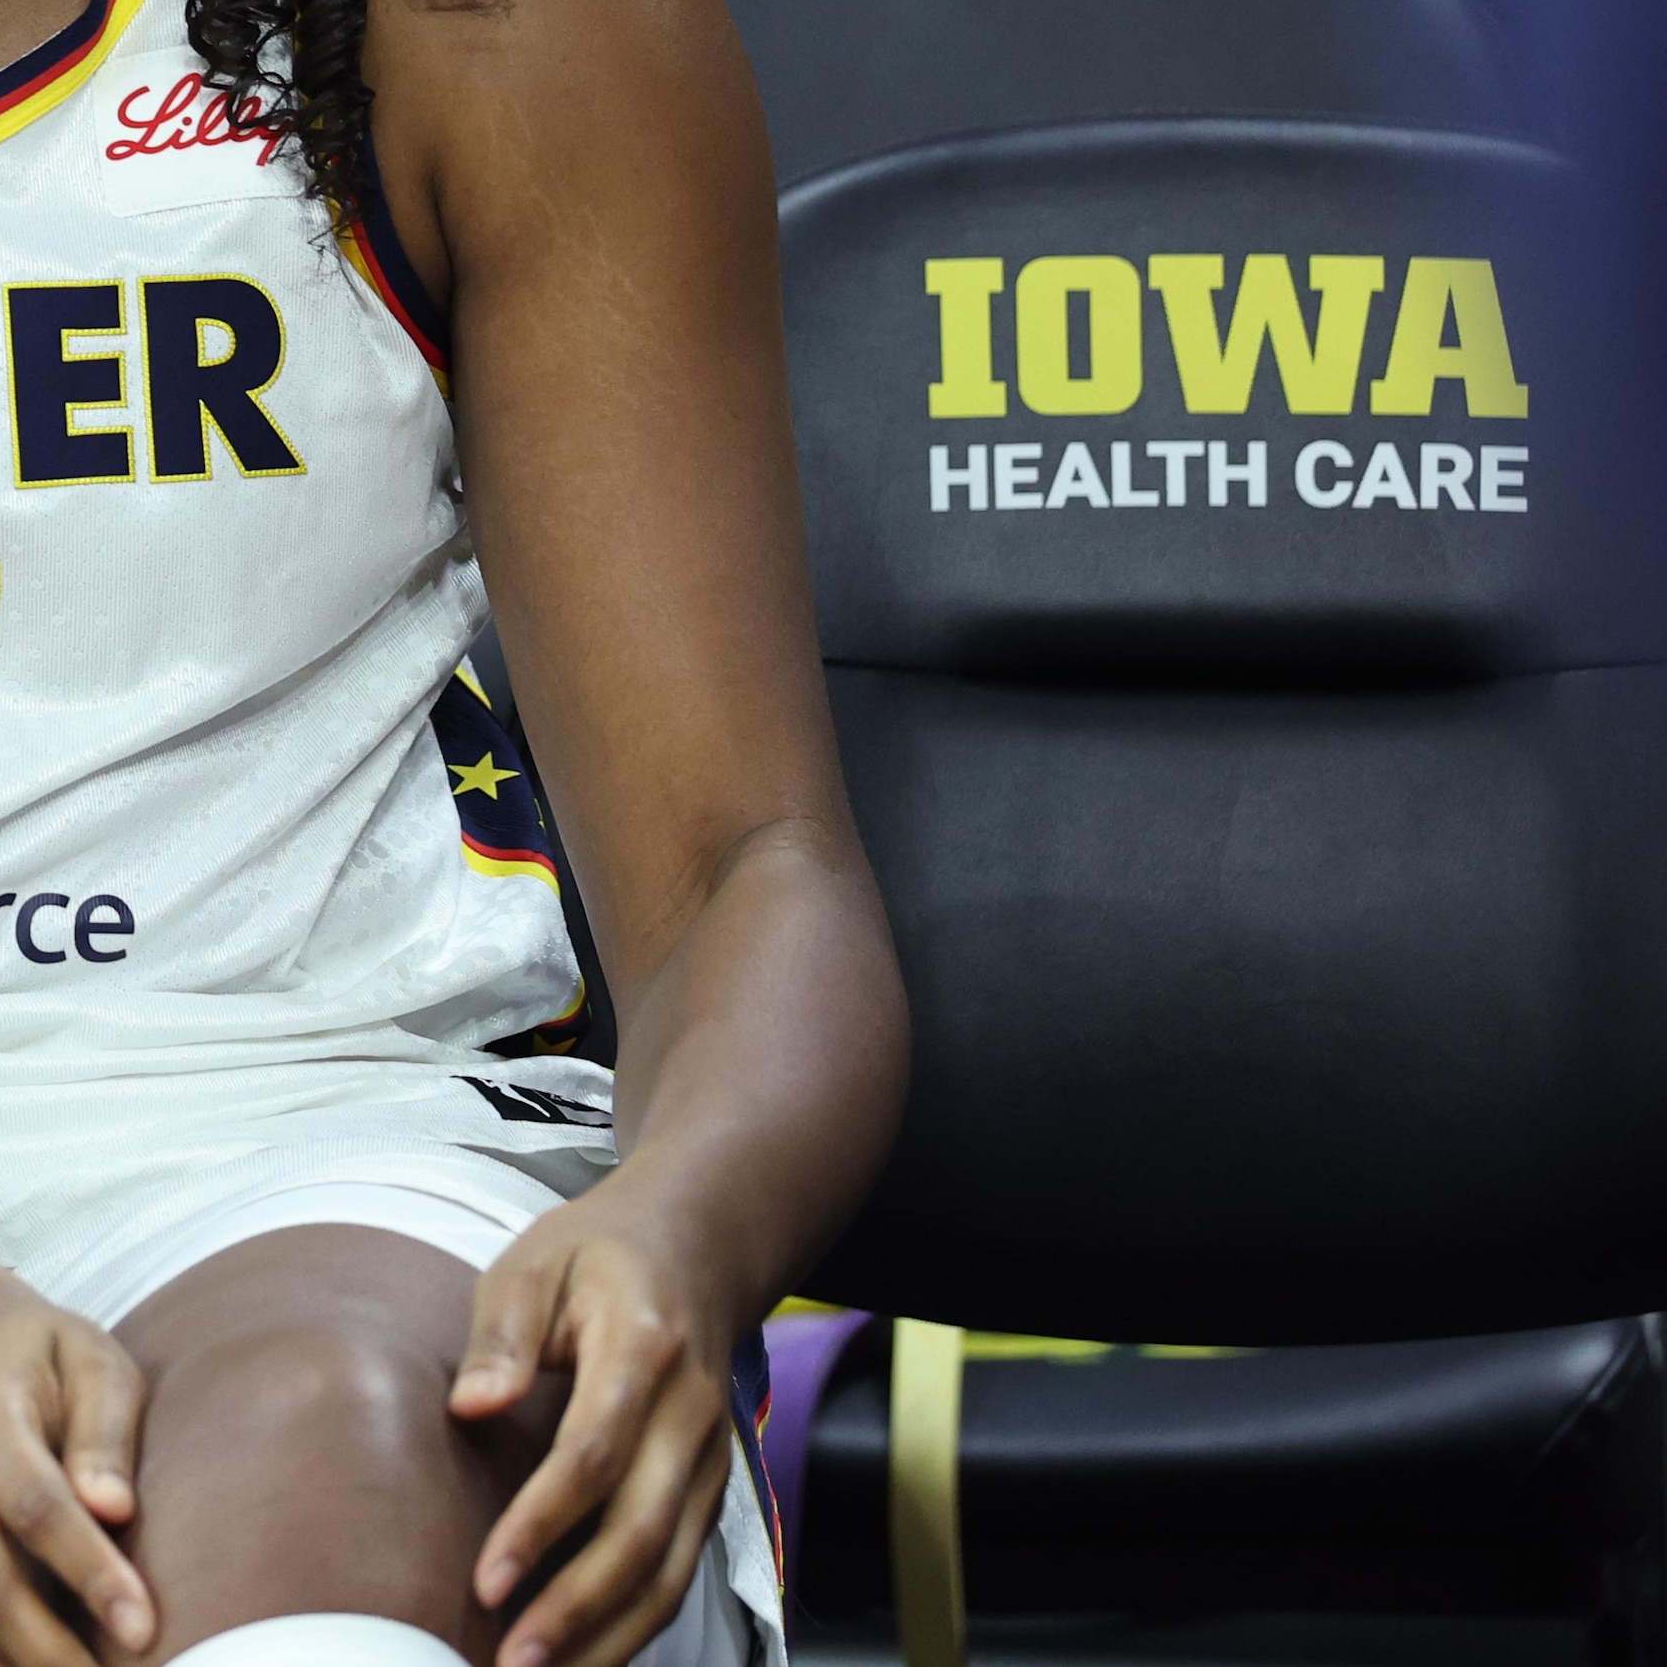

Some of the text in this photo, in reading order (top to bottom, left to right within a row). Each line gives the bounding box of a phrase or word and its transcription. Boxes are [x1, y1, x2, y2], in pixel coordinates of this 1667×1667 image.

[925, 253, 1529, 419] IOWA
[929, 440, 1529, 512] HEALTH CARE
